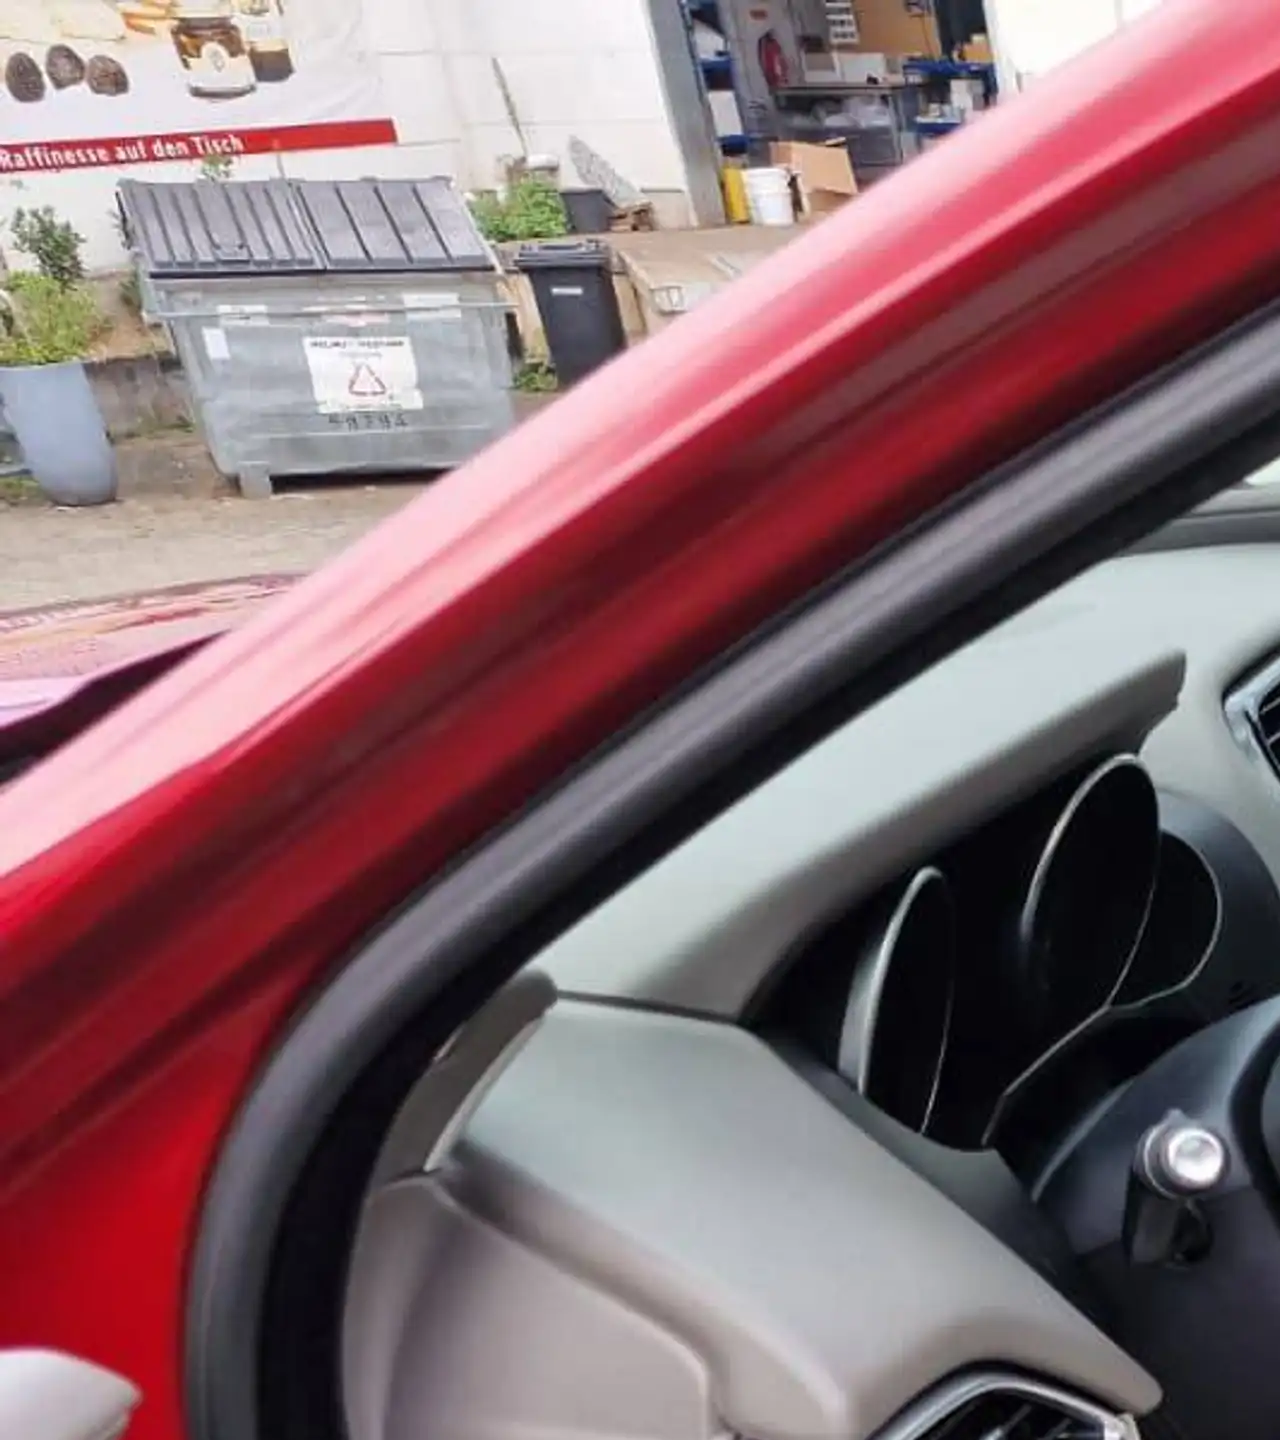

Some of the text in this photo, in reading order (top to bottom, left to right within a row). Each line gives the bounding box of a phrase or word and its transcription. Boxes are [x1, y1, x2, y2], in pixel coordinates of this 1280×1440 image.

[0, 134, 244, 171] Raffinesse auf den Tisch
